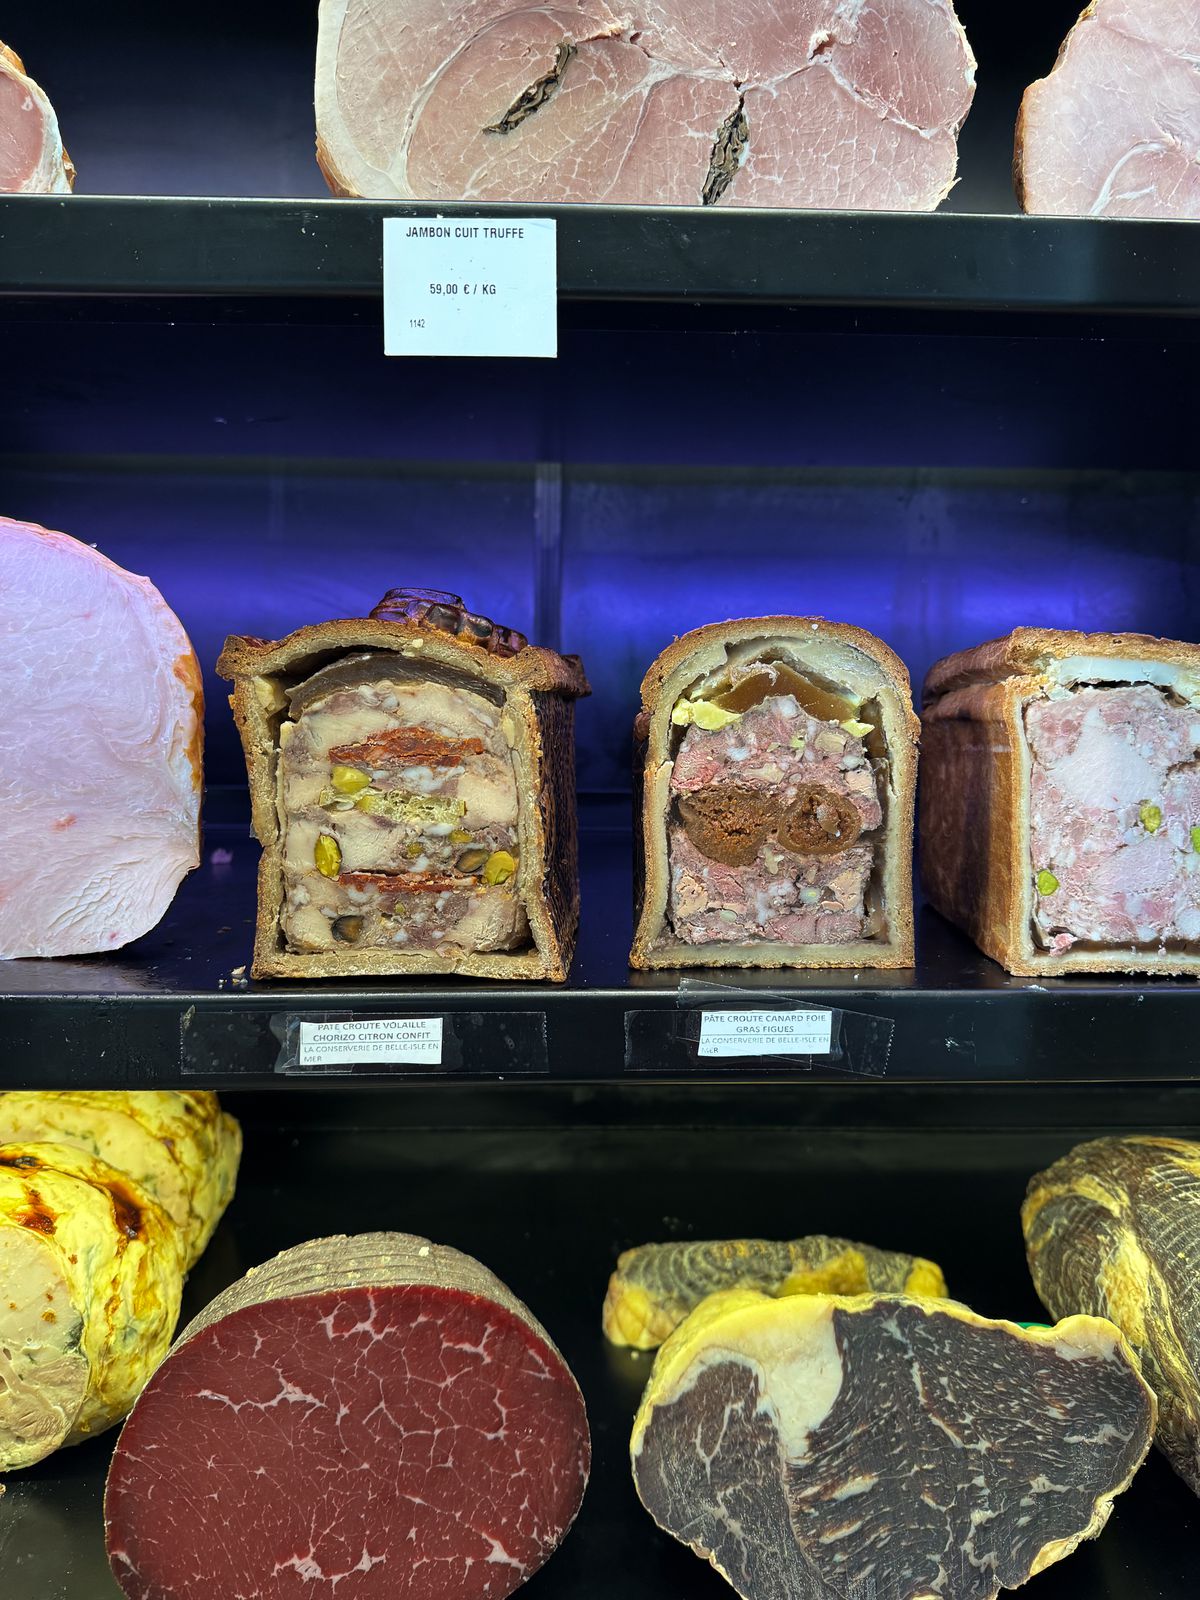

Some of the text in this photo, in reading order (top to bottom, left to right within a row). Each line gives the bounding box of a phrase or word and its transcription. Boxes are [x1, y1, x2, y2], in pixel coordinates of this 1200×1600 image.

[406, 226, 524, 238] JAMBON CUIT TRUFFE
[430, 284, 458, 296] 59,00
[464, 284, 470, 295] €
[482, 284, 496, 295] KG
[409, 318, 426, 328] 1142
[383, 1021, 426, 1029] VOLAILLE
[313, 1032, 431, 1042] CHORIZO CITRON CONFIT
[316, 1045, 370, 1053] CONSERVERIE
